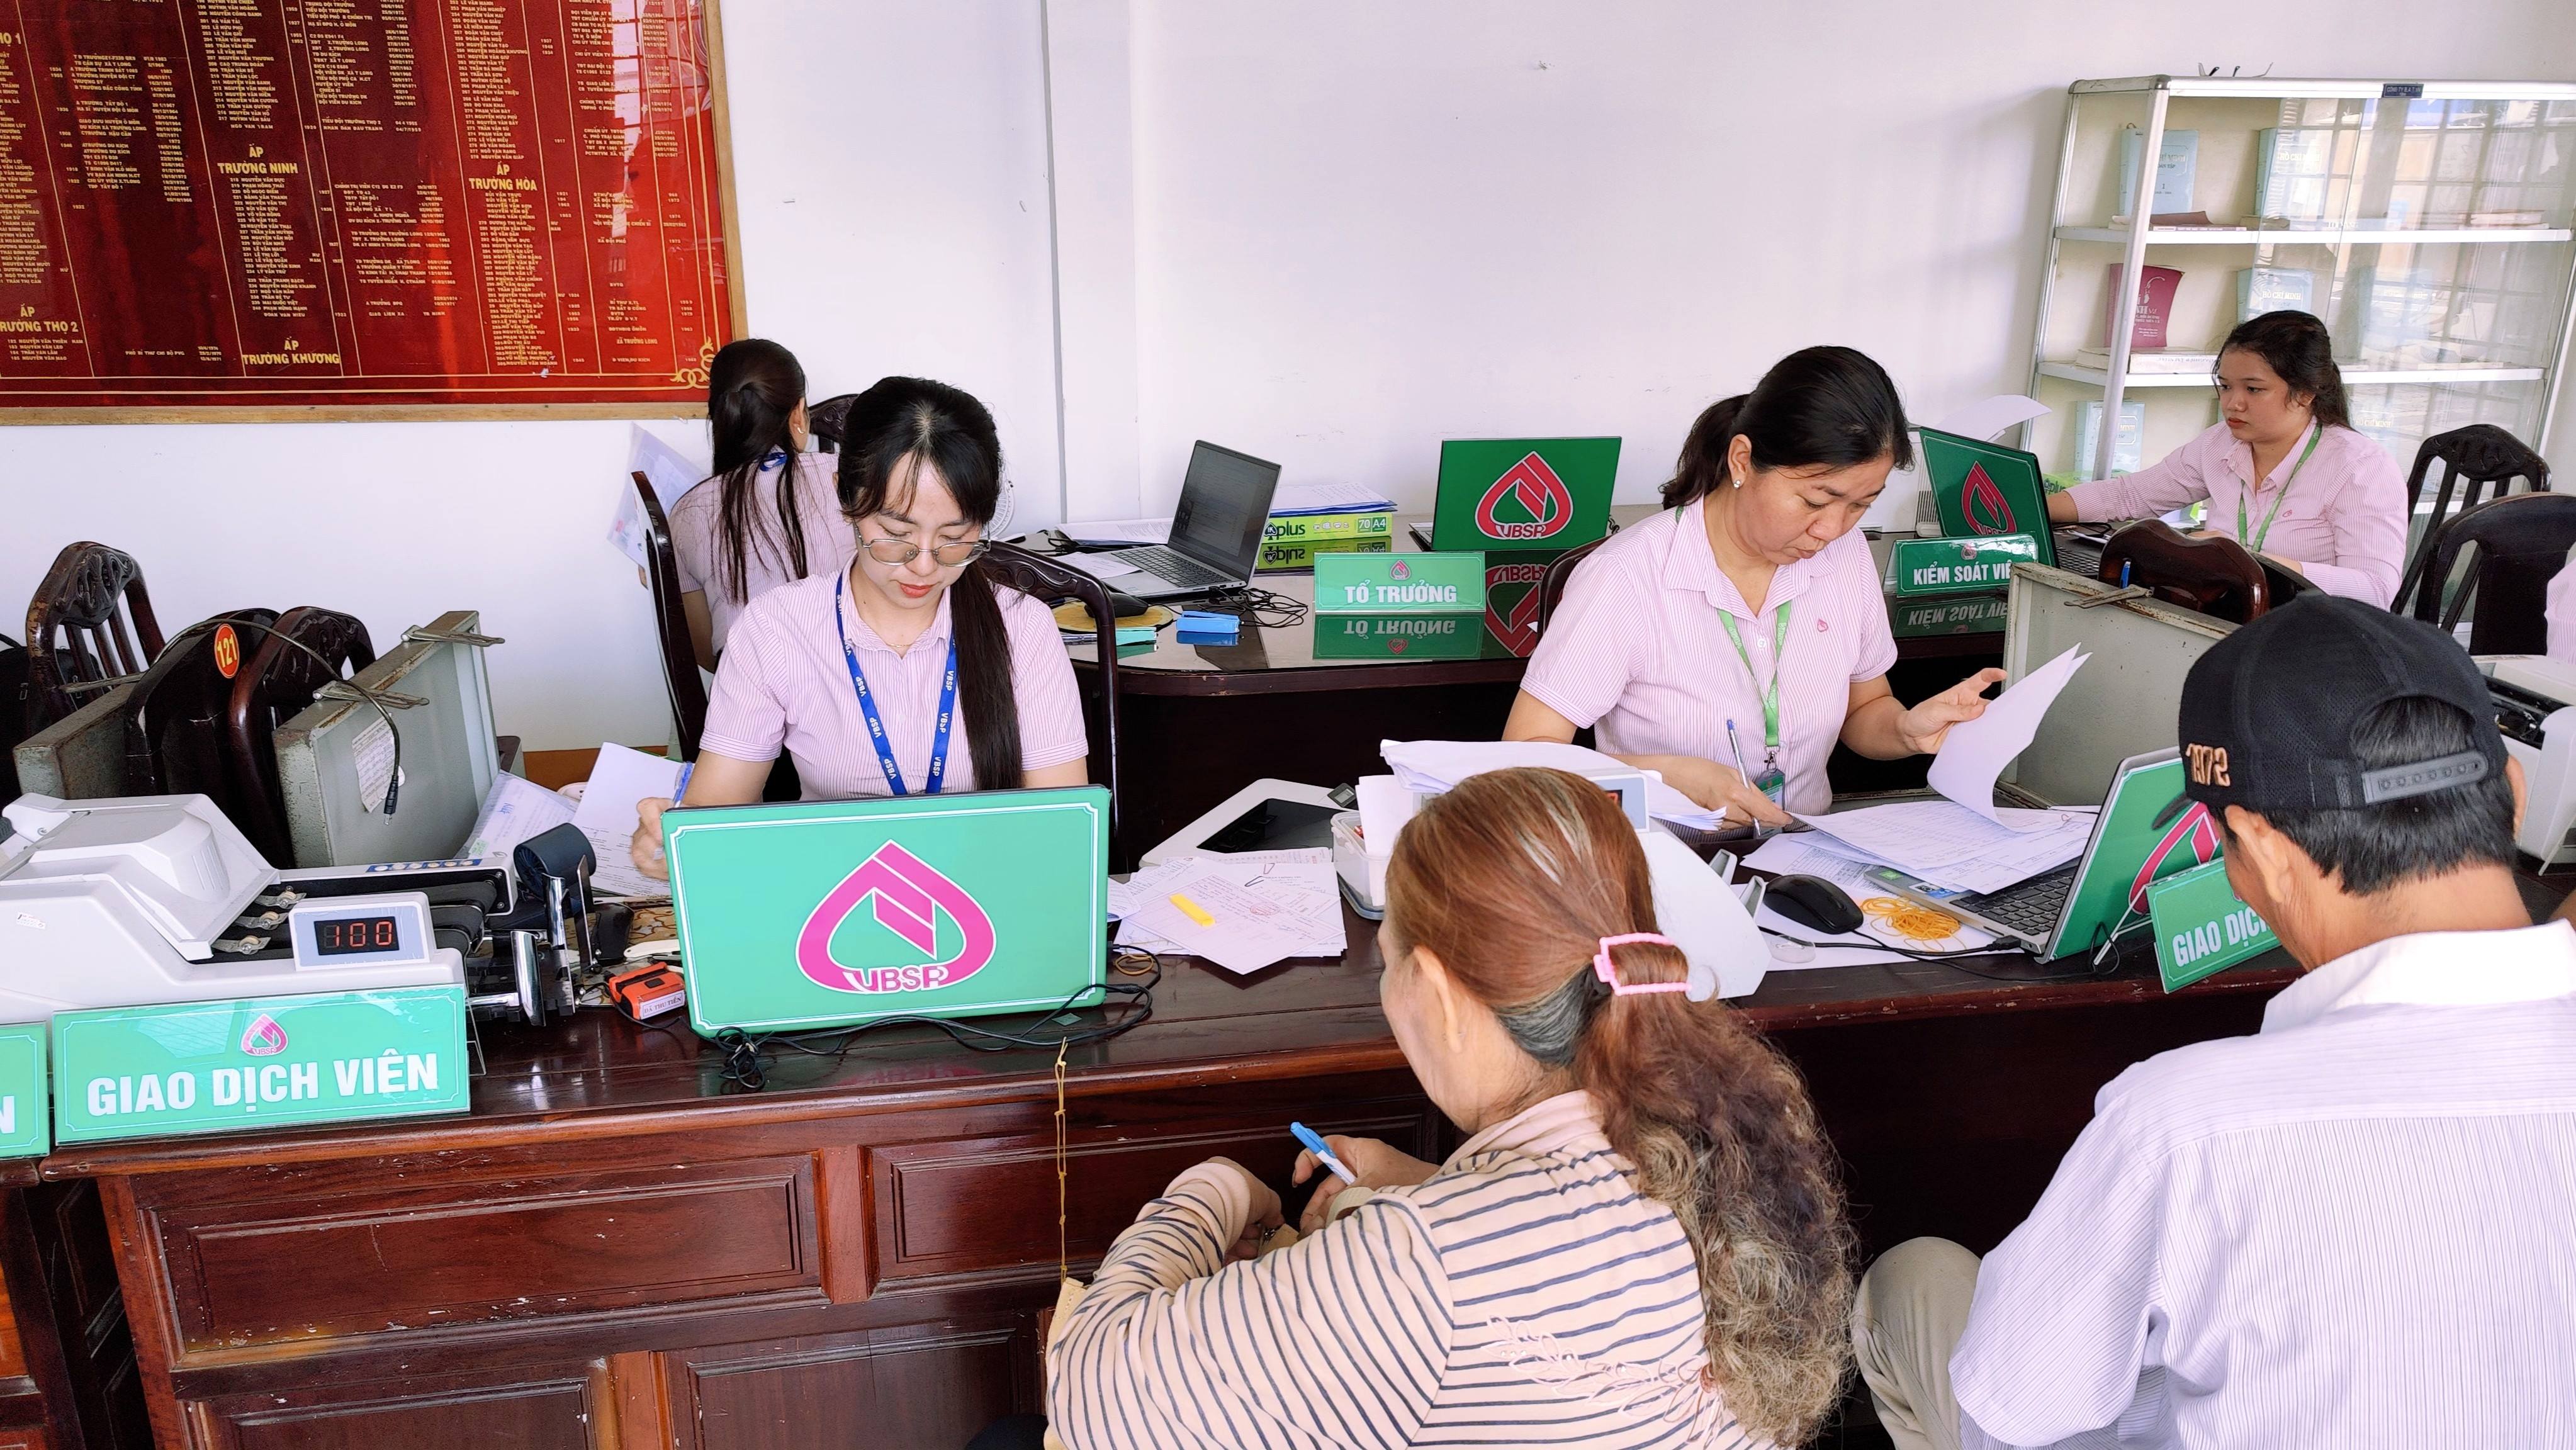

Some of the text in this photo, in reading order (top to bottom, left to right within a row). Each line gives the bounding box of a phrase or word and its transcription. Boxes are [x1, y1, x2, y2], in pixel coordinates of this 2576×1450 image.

[249, 143, 264, 157] ẤP
[217, 160, 298, 174] TRƯỜNG NINH
[497, 160, 510, 175] ẤP
[469, 176, 537, 191] TRƯỜNG HÒA
[21, 303, 35, 317] ẤP
[0, 319, 79, 334] RƯỜNG THỌ 2
[242, 352, 340, 364] TRƯỜNG KHƯƠNG
[1276, 521, 1305, 540] plus
[1358, 519, 1386, 529] 70 A4
[1913, 559, 2012, 585] KIỂM SOÁT VIÊ
[1344, 579, 1457, 604] TỔ TRƯỞNG
[215, 637, 239, 668] 121
[855, 676, 867, 697] VBSP
[945, 670, 954, 691] VBSP
[869, 717, 882, 738] VBSP
[940, 712, 949, 733] VBSP
[884, 758, 896, 780] VBSP
[933, 756, 942, 777] VBSP
[335, 921, 393, 947] 100
[2173, 920, 2222, 967] GIAO
[86, 1047, 438, 1116] GIAO DỊCH VIÊN
